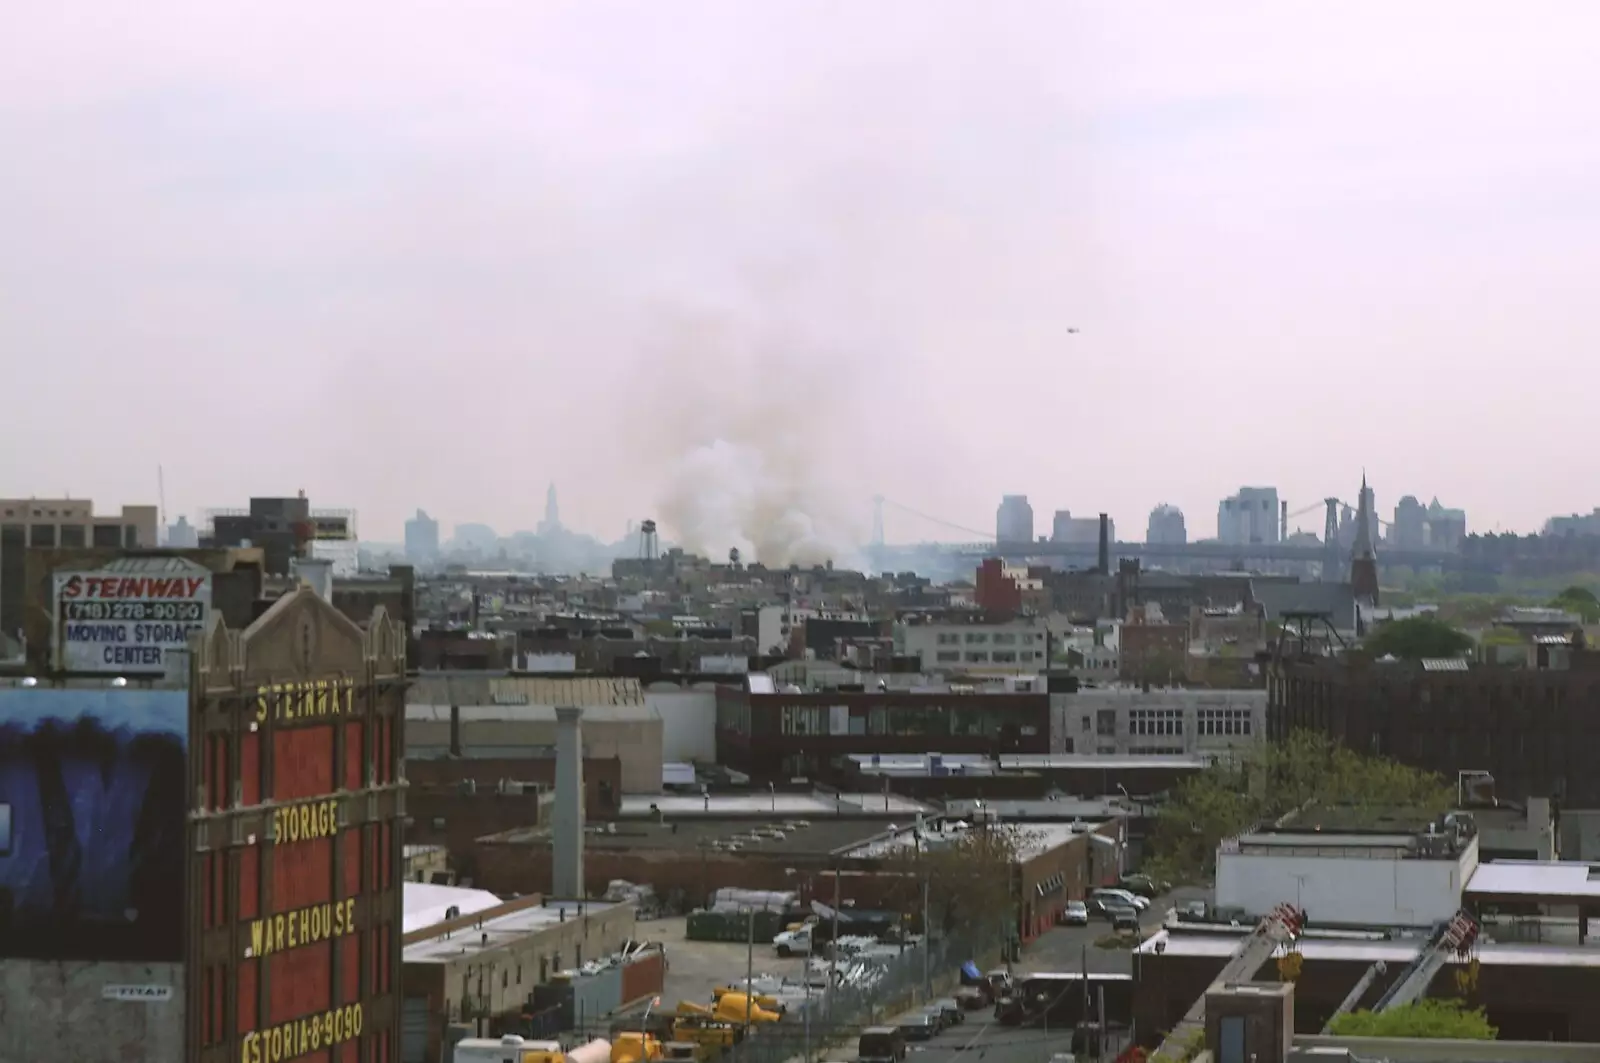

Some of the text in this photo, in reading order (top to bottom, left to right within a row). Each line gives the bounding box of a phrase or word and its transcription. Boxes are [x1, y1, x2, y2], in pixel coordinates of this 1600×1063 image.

[64, 575, 204, 598] STEINWAY
[67, 624, 203, 642] MOVING STORA
[103, 646, 161, 664] CENTER
[256, 676, 353, 721] STEINWAY
[274, 800, 338, 844] STORAGE
[251, 898, 356, 957] WAREHOUSE
